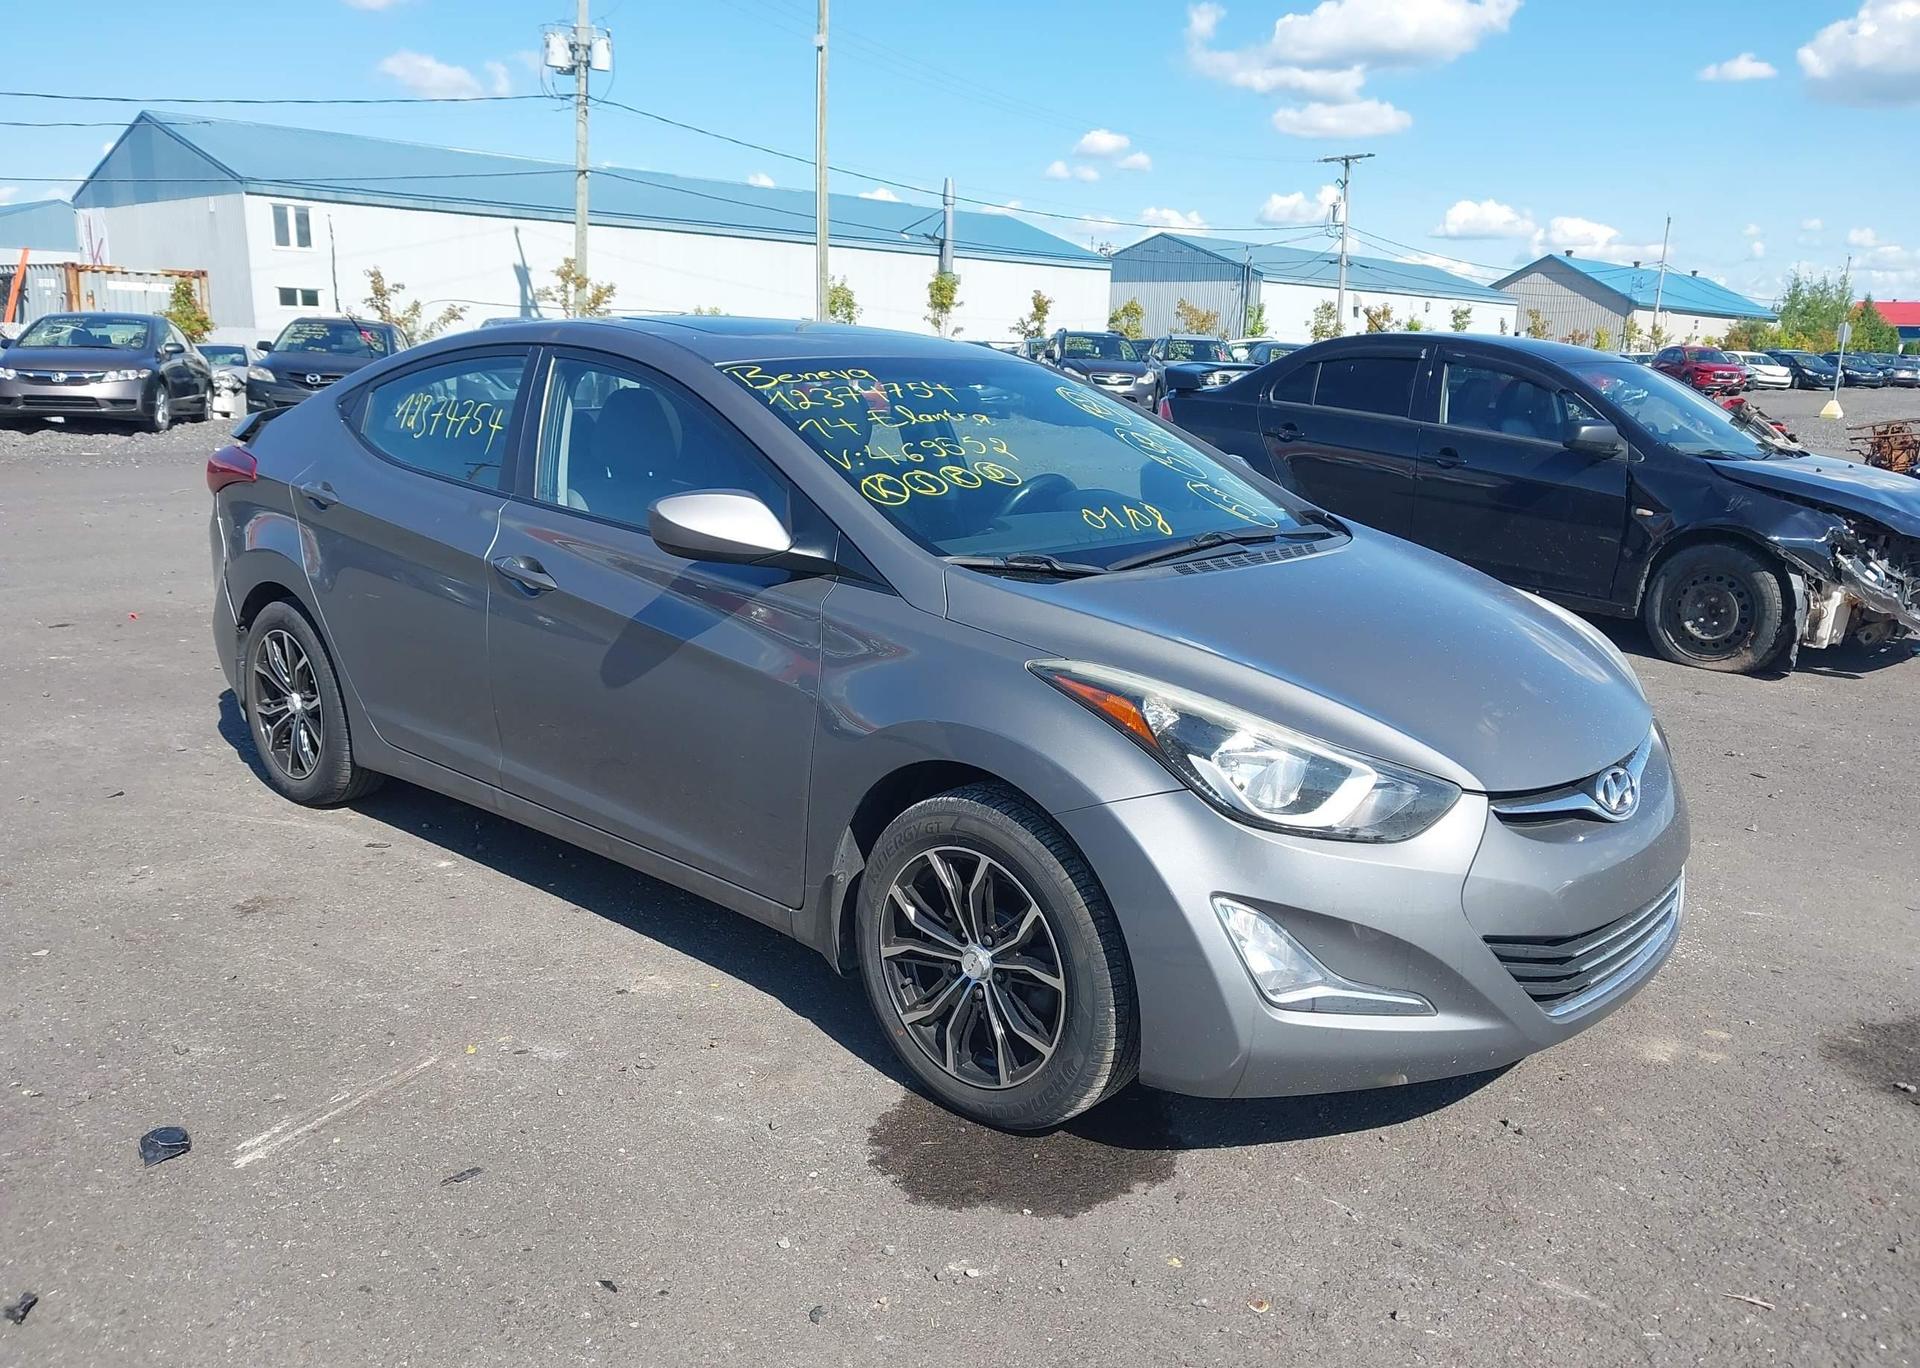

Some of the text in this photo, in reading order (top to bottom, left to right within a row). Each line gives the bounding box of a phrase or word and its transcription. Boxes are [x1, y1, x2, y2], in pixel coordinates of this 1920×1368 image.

[768, 381, 959, 410] 12374754
[798, 405, 994, 439] 14 Elantra
[867, 821, 943, 884] KINERGY GT
